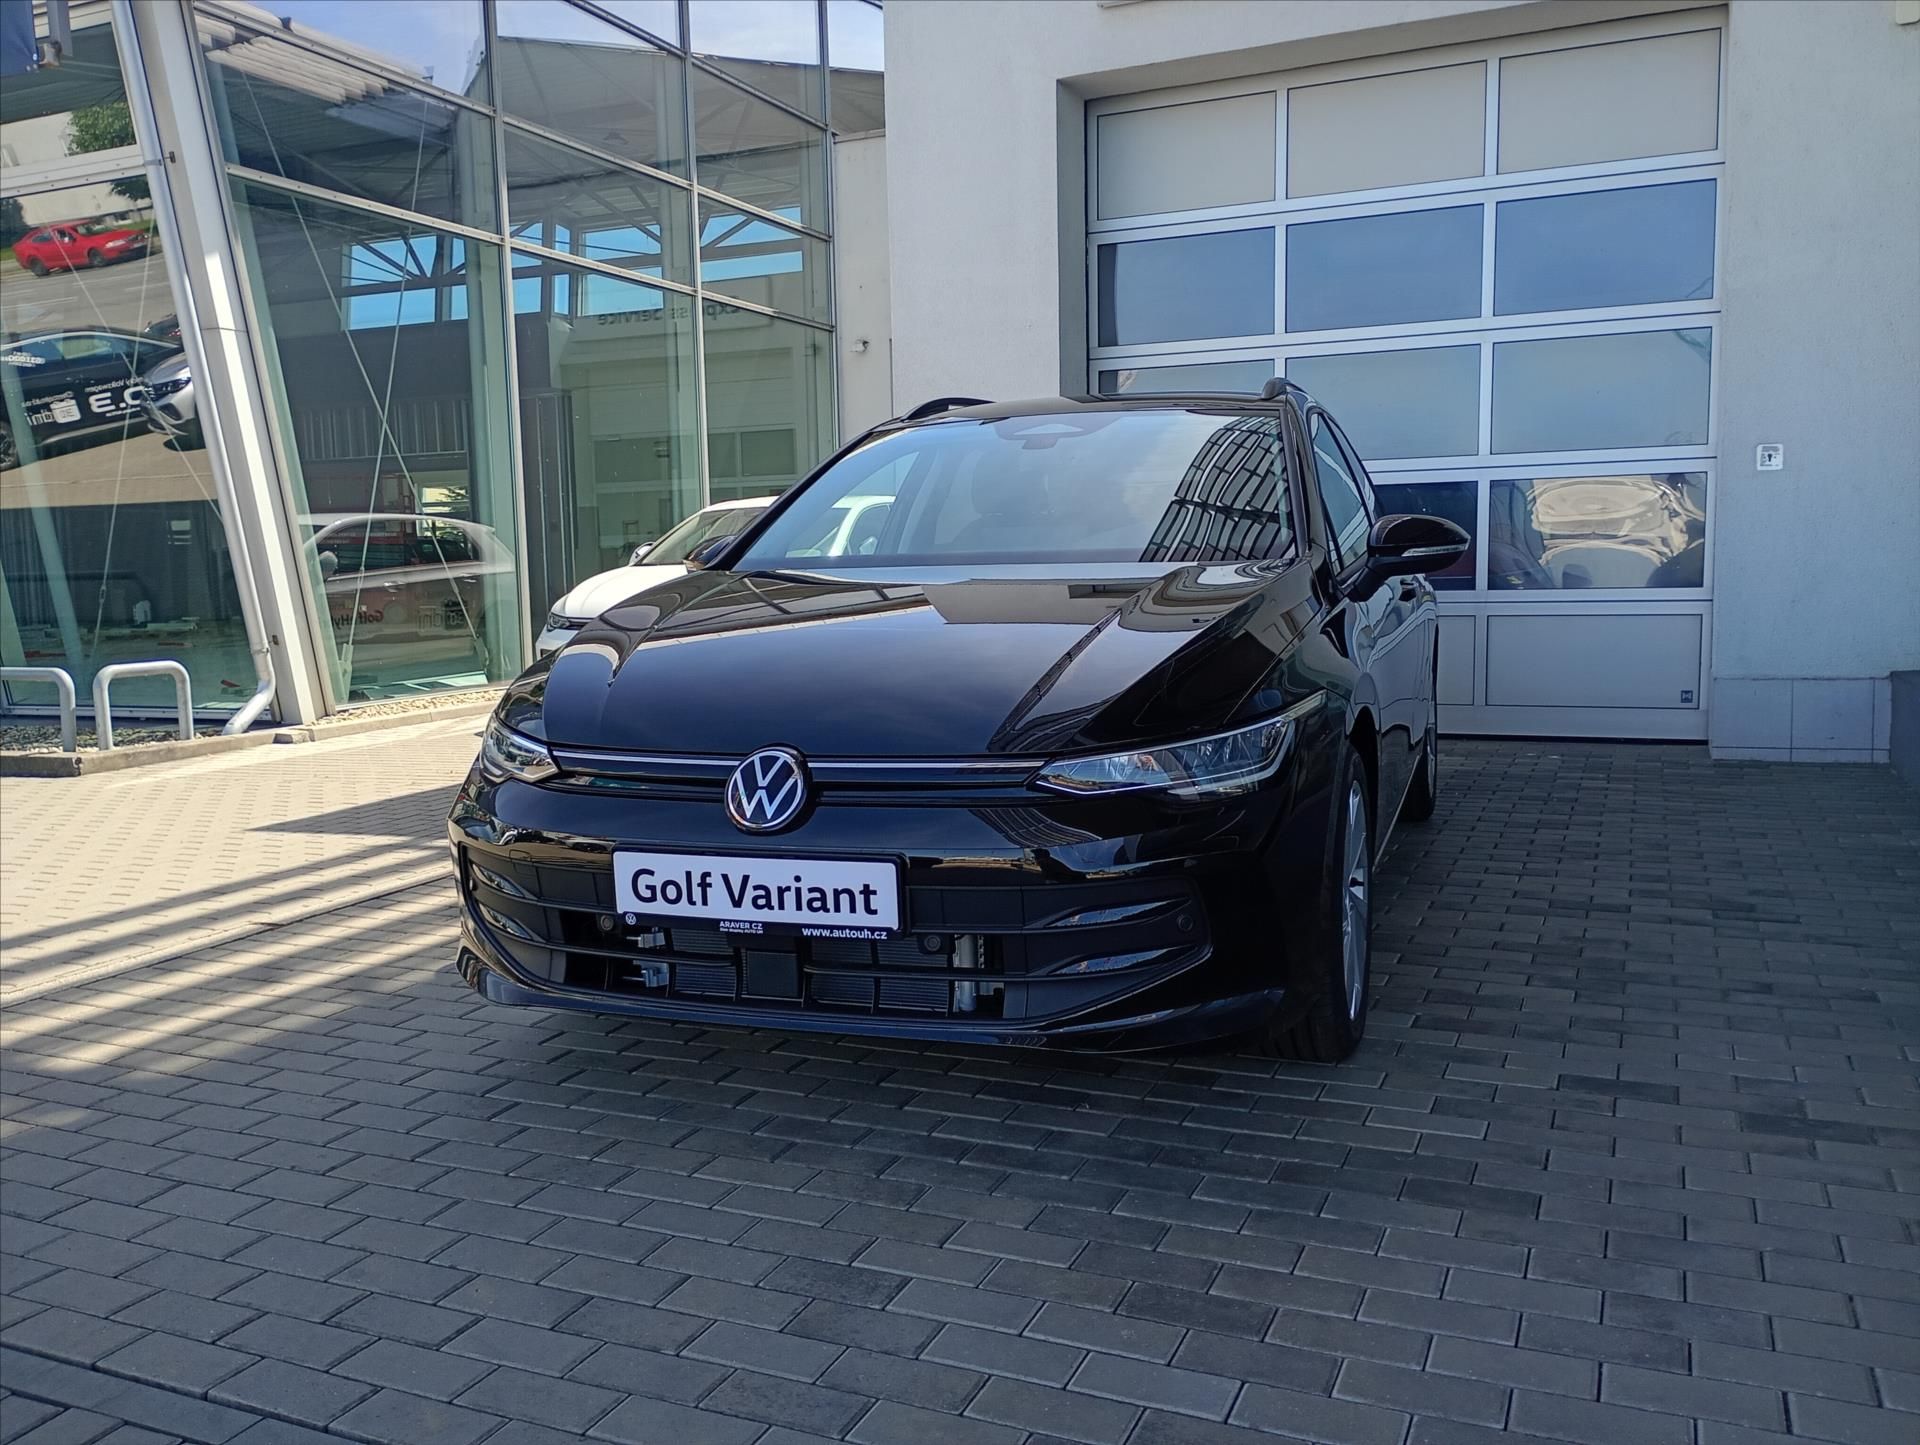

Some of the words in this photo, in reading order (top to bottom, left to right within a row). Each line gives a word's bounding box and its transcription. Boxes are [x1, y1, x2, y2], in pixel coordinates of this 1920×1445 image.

[631, 868, 713, 907] Golf
[721, 873, 878, 916] Variant
[719, 920, 750, 930] ARAVER
[751, 922, 763, 931] CZ
[801, 927, 888, 940] www.autouh.cz
